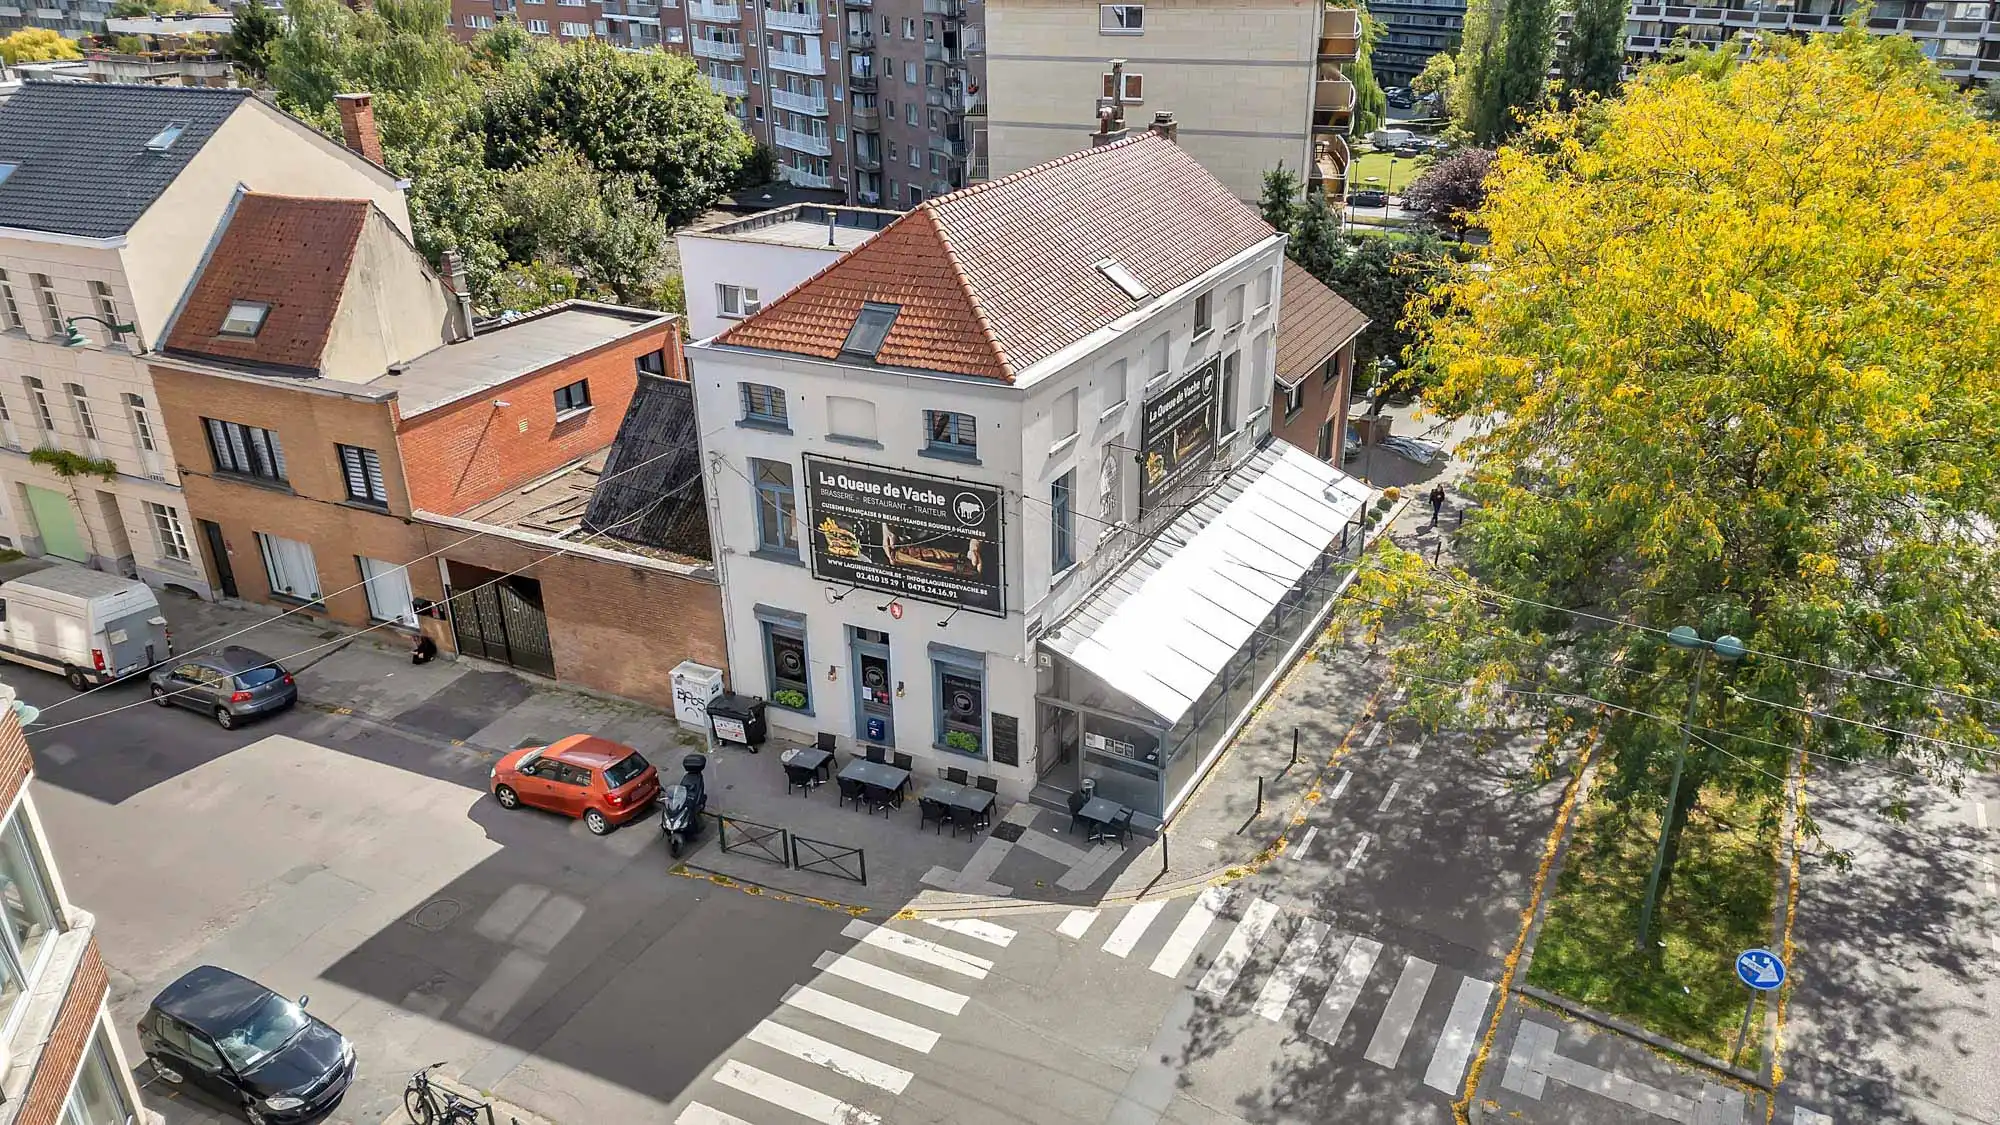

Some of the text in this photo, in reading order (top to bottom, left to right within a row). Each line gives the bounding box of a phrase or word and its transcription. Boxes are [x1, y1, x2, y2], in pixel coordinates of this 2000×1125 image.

[819, 471, 946, 506] La Queue de Vache
[820, 488, 855, 502] BRASSERIE
[863, 496, 907, 511] RESTAURANT
[914, 505, 947, 518] TRAITEUR
[821, 502, 845, 512] CUISINE
[845, 506, 878, 518] FRANÇAISE
[882, 513, 900, 522] BELGE
[928, 522, 951, 531] ROUGES
[907, 582, 958, 599] 0475.24.16.91
